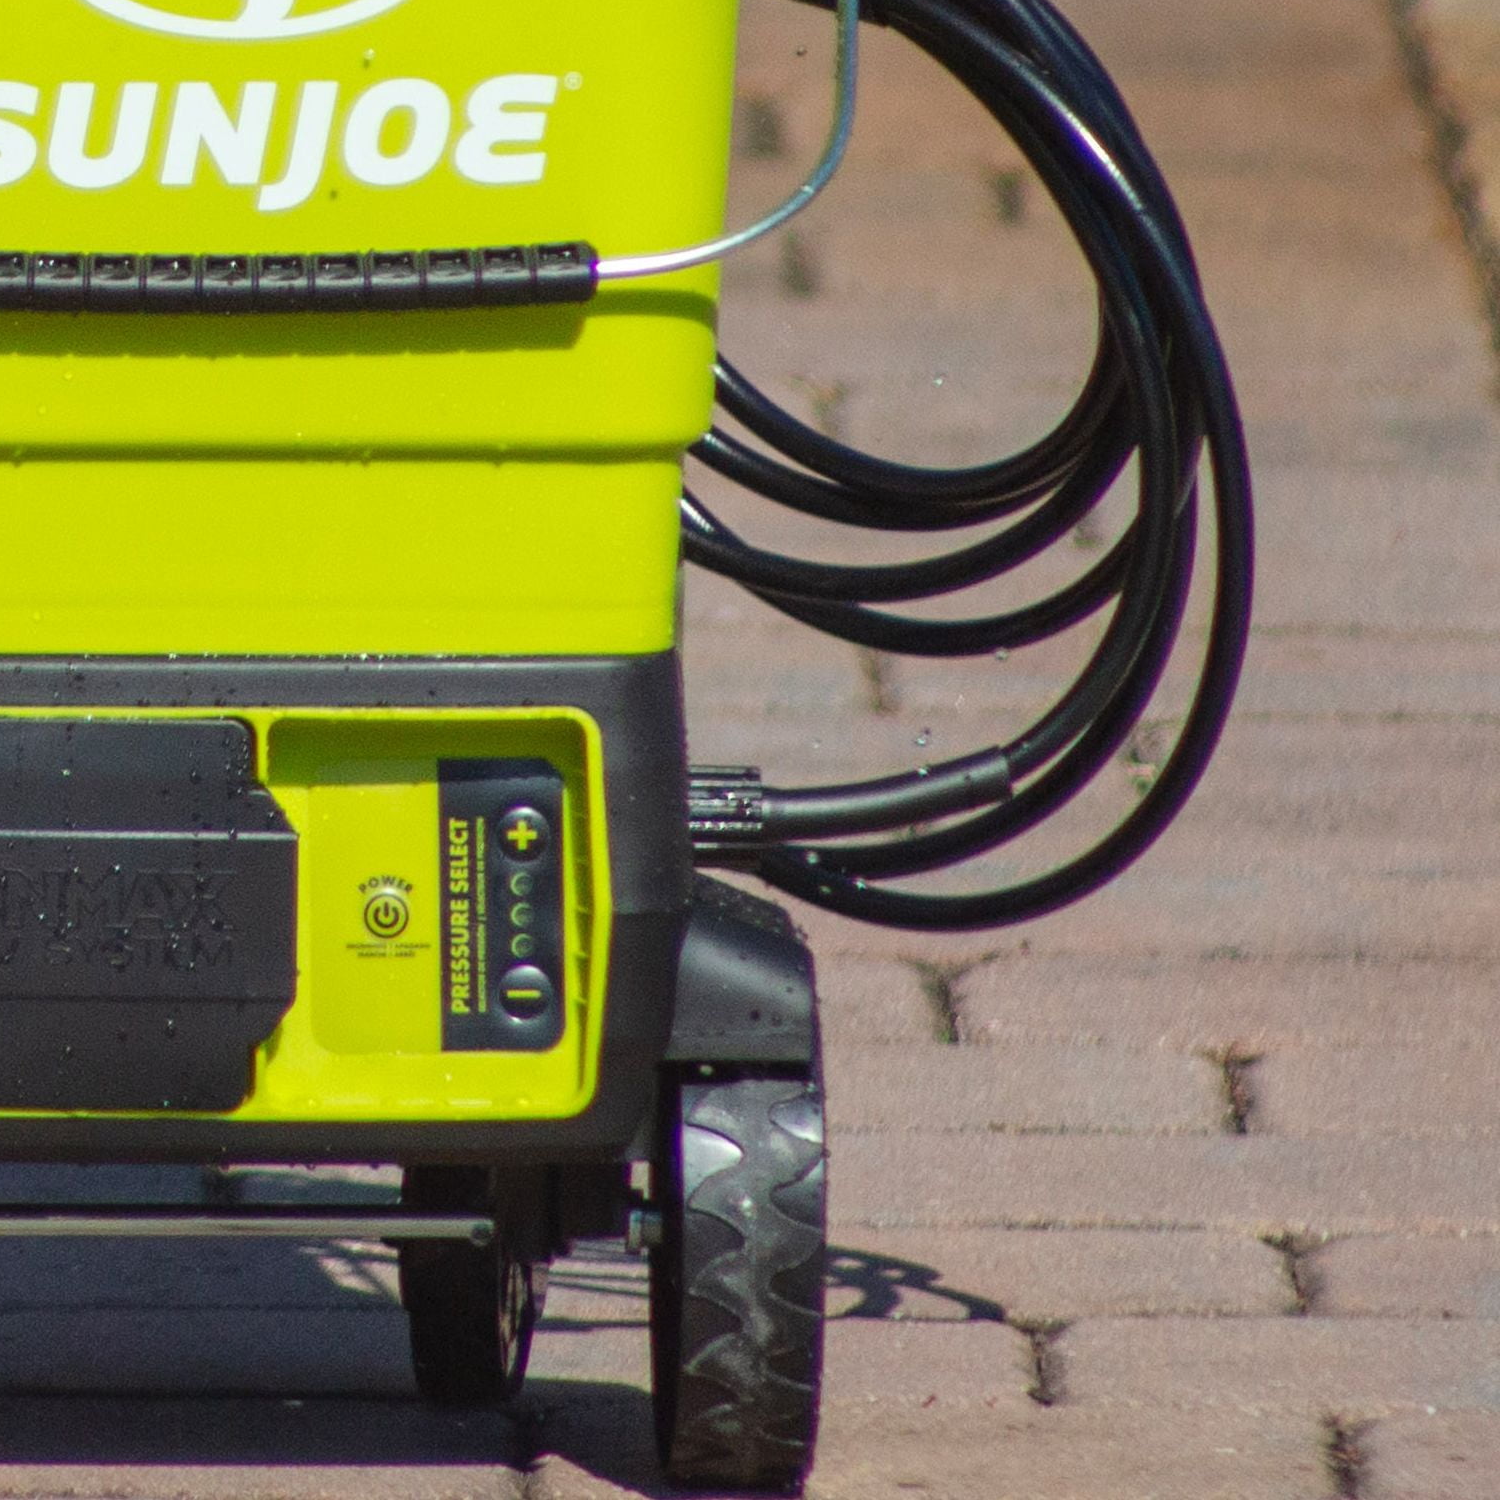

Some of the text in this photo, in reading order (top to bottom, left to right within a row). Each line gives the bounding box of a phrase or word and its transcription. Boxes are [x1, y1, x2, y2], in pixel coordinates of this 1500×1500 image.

[357, 874, 414, 895] POWER
[449, 817, 471, 1014] PRESSURE SELECT
[46, 934, 234, 968] SYSTEM
